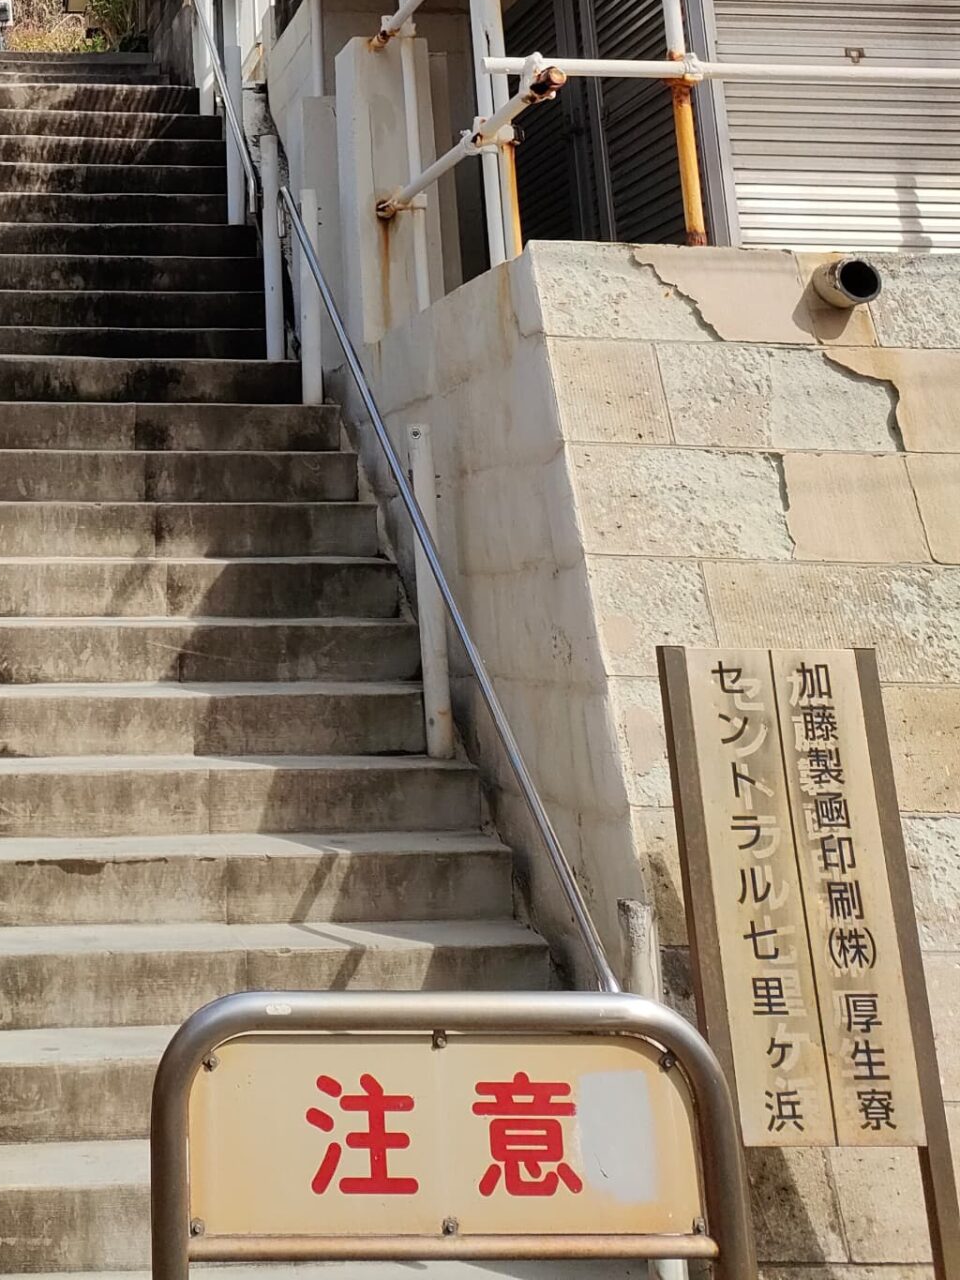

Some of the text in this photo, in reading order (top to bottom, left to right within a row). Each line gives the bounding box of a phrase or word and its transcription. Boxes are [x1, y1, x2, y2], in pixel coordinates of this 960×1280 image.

[844, 993, 897, 1132] 厚生寮
[306, 1071, 583, 1197] 注意
